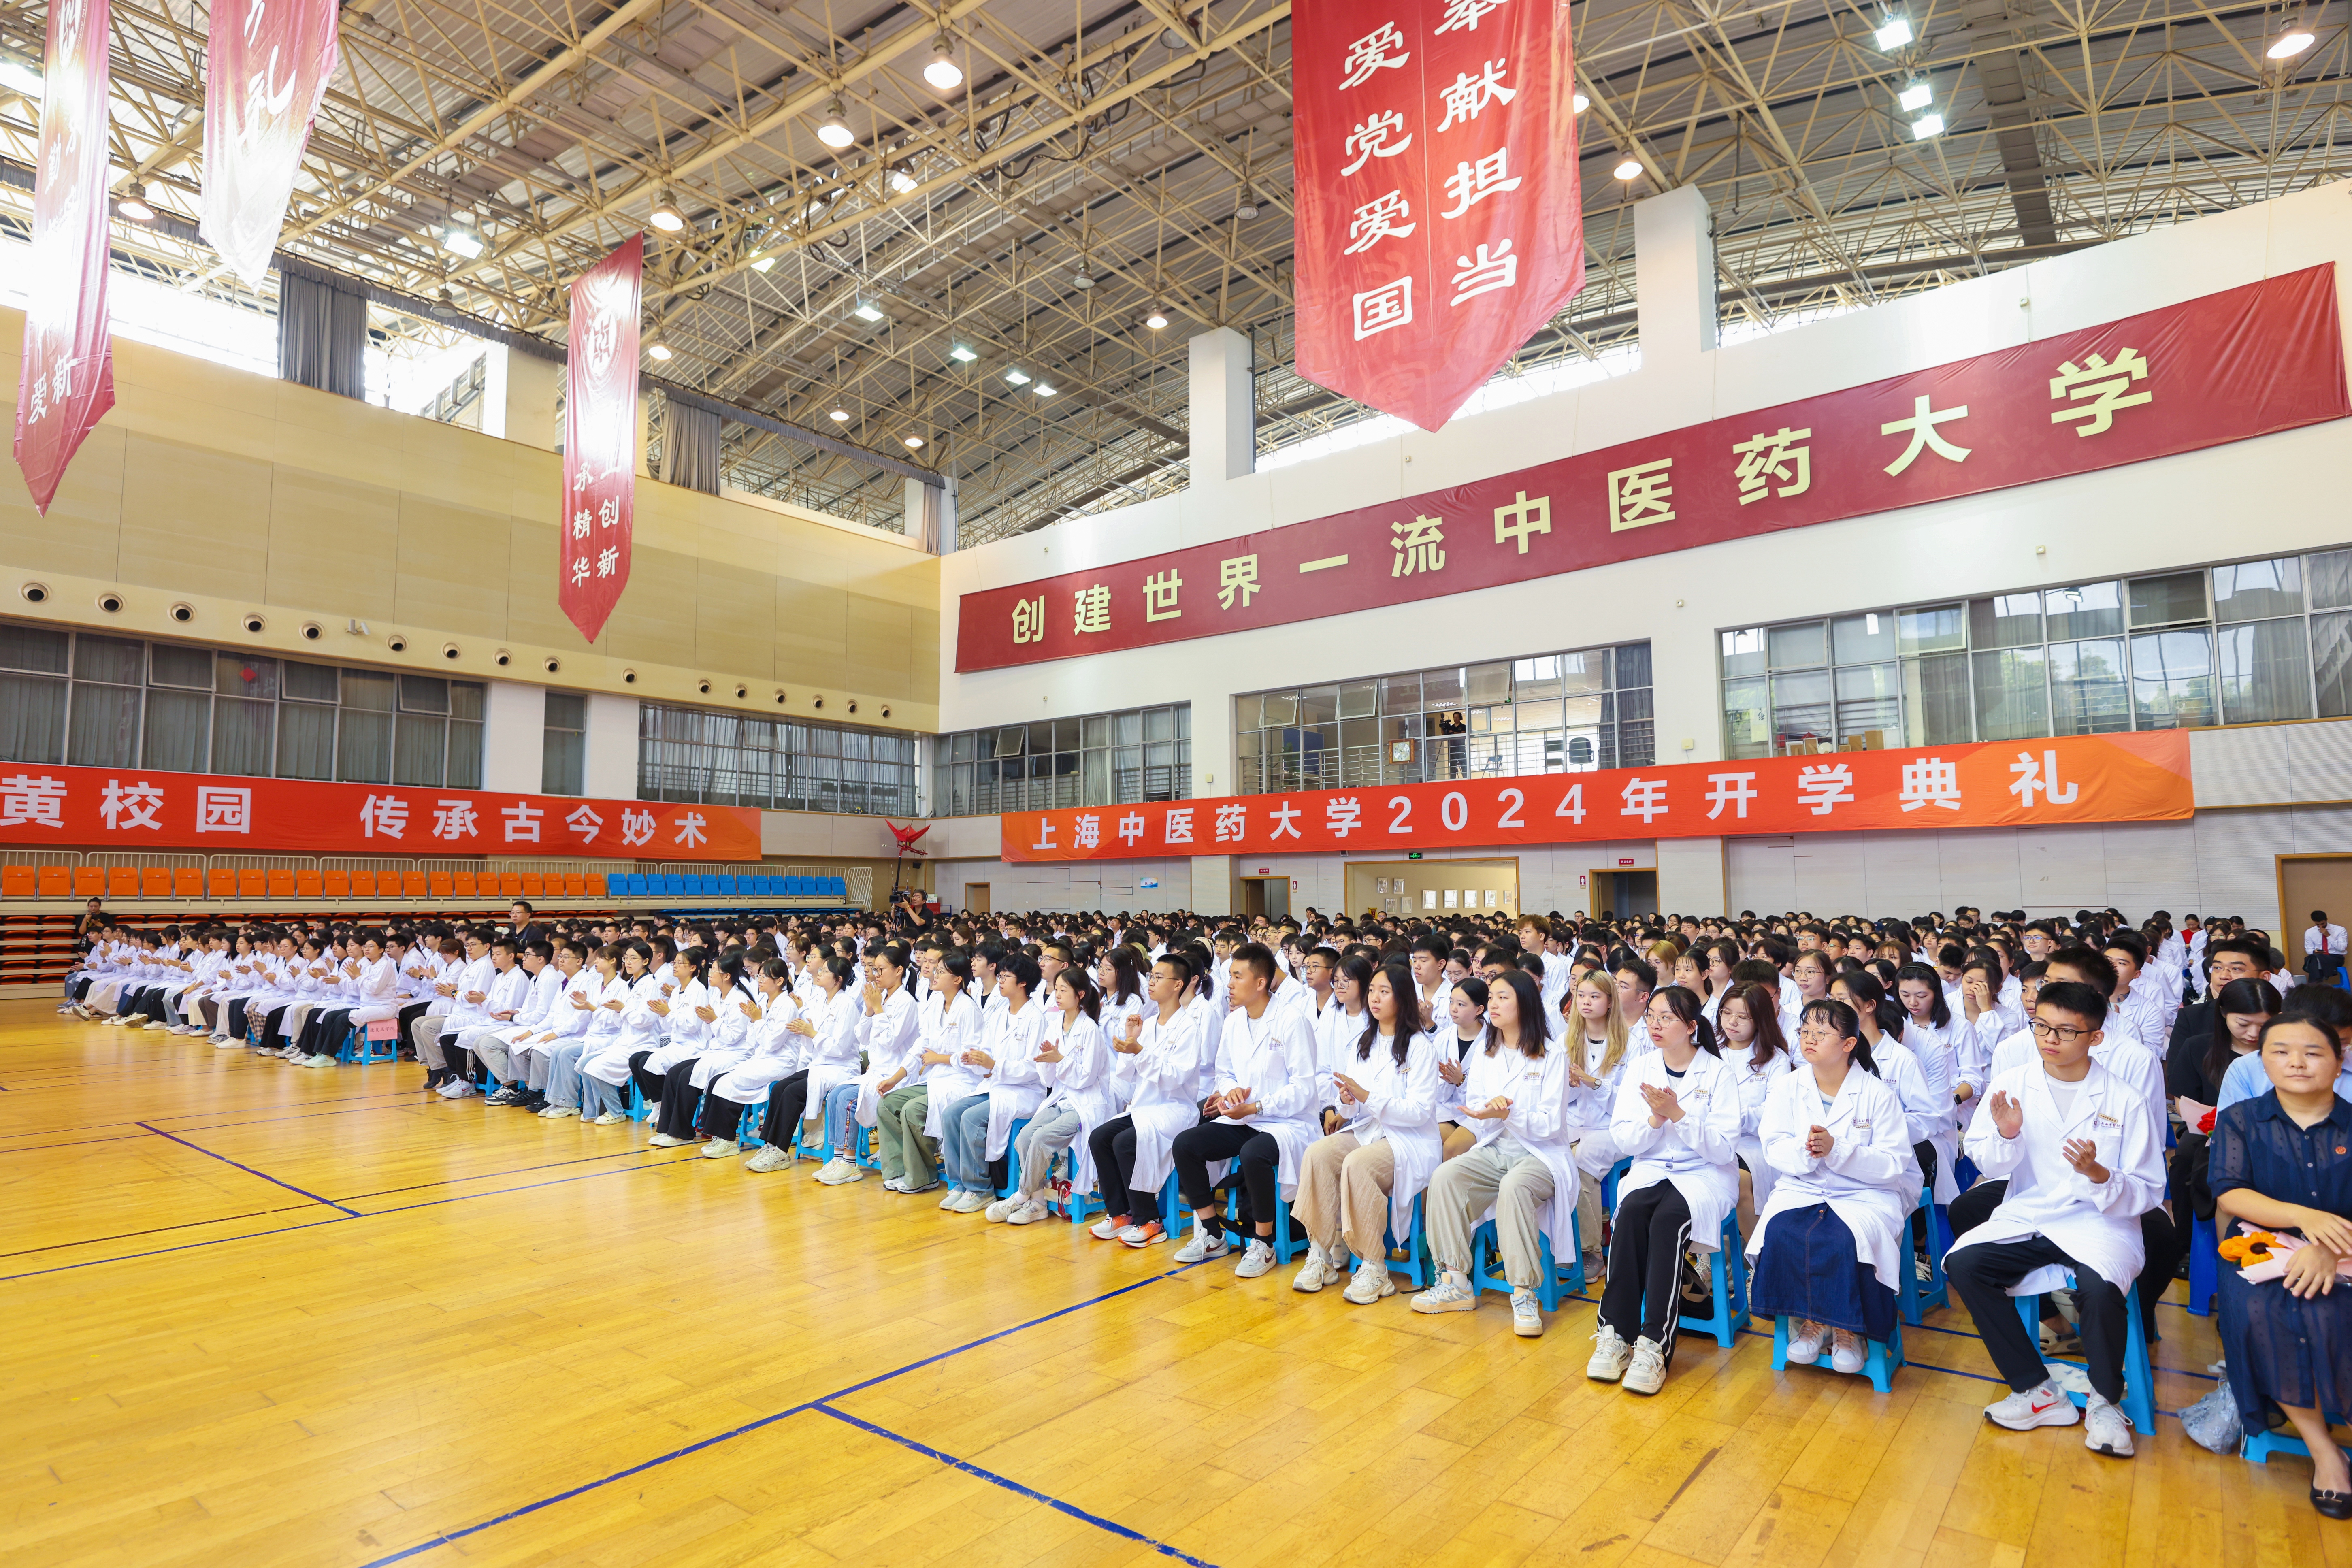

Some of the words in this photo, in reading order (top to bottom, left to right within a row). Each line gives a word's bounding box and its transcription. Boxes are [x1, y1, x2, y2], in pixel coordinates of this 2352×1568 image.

[1338, 20, 1417, 341] 爱党爱国
[1012, 347, 2152, 644] 创建世界一流中医药大学
[0, 774, 251, 834] 黄校园
[359, 793, 708, 849] 传承古今妙术
[1032, 750, 2078, 850] 上海中医药大学2024年开学典礼
